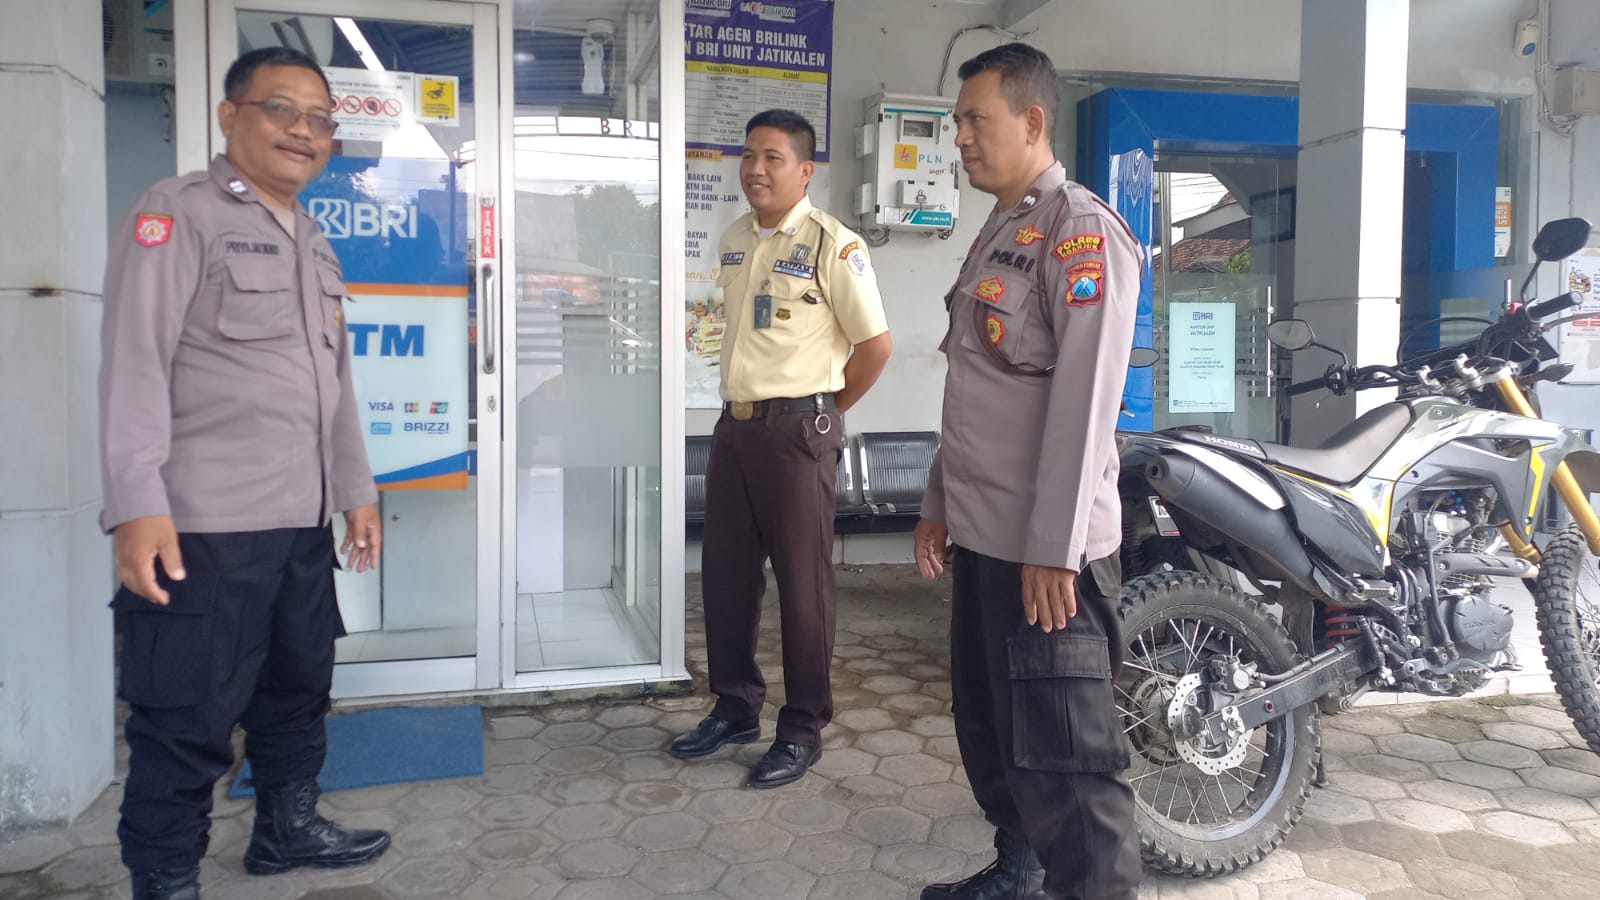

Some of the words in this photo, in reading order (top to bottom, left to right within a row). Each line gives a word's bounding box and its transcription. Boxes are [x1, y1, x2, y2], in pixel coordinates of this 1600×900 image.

[717, 26, 751, 43] AGEN
[756, 30, 807, 49] BRILINK
[696, 41, 718, 57] BRI
[723, 44, 754, 60] UNIT
[756, 47, 825, 67] JATIKALEN
[918, 154, 942, 164] PLN
[687, 173, 706, 182] BANK
[706, 174, 722, 183] LAIN
[685, 183, 700, 191] ATM
[701, 184, 713, 192] BRI
[685, 192, 700, 200] ATM
[701, 194, 719, 202] BANK
[700, 203, 712, 211] BRI
[354, 203, 418, 238] BRI
[483, 210, 492, 255] TARIK
[989, 249, 1036, 273] POLRI
[1200, 311, 1213, 321] BRI
[368, 402, 394, 411] VISA
[404, 422, 449, 432] BRIZZI
[1203, 435, 1262, 454] HONDA
